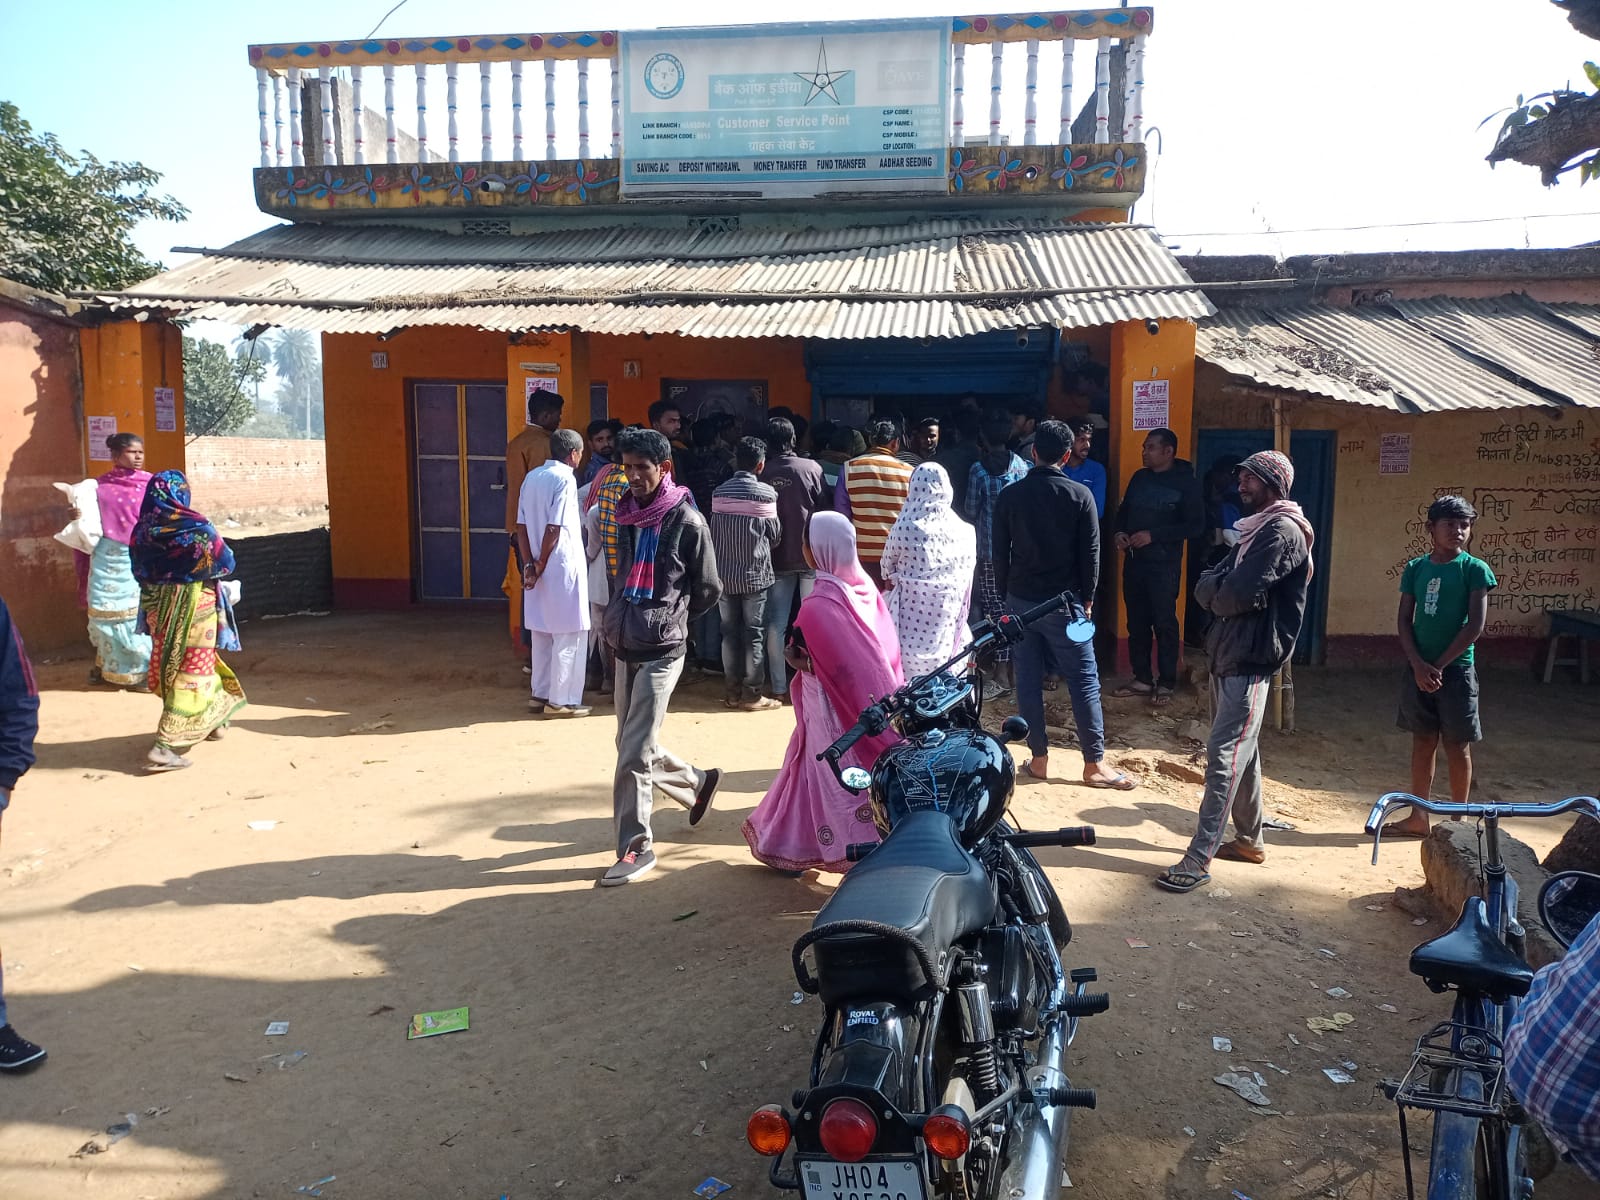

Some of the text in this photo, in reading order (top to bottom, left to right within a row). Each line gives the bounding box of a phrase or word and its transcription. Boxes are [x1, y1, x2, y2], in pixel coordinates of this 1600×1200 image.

[717, 117, 769, 129] Customer
[776, 115, 818, 128] Service
[821, 113, 850, 126] Point
[636, 156, 933, 173] SAVING A/C DEPOSIT WITHDRAWL MONEY TRANSFER FUND TRANSFER AADHAR SEEDING
[850, 1010, 876, 1018] ROYAL
[847, 1017, 879, 1027] ENFIELD
[832, 1165, 889, 1189] JH04
[809, 1183, 822, 1191] IND
